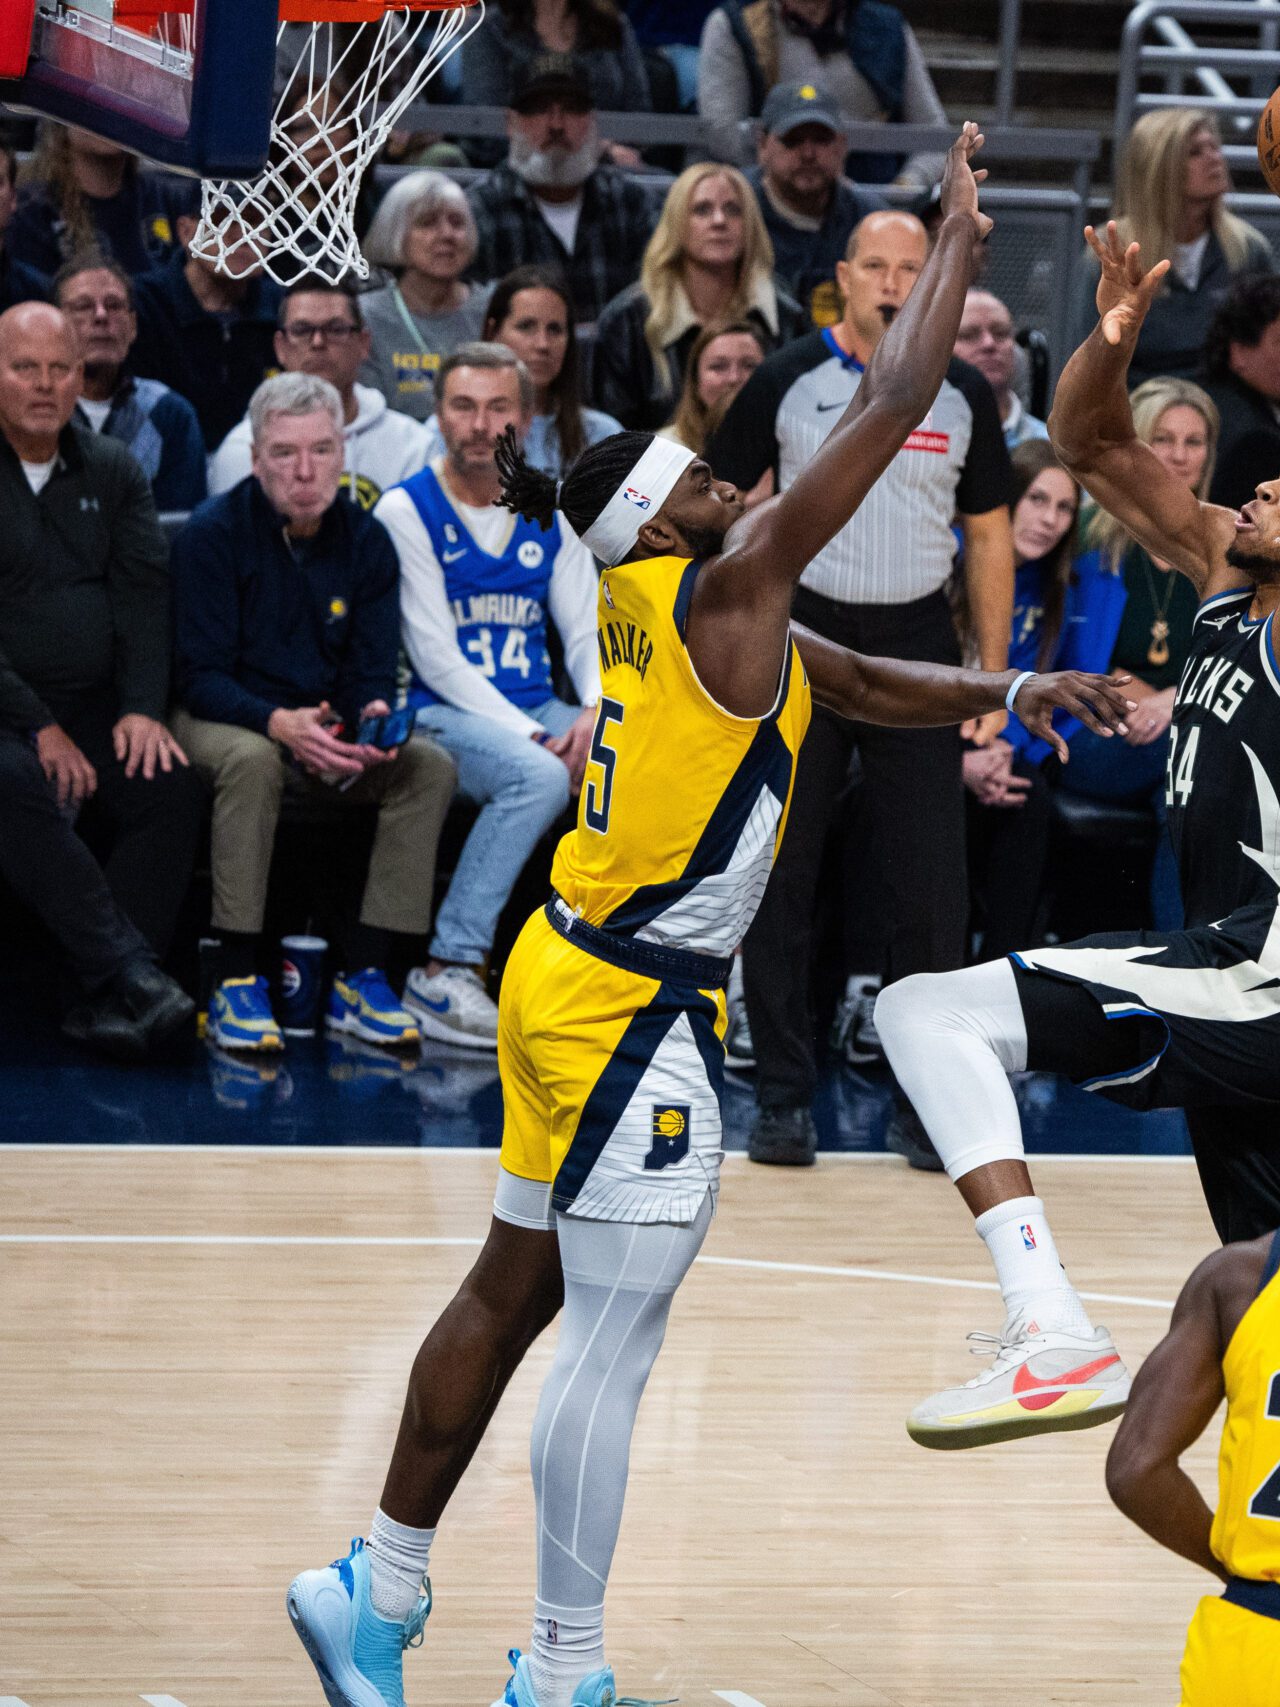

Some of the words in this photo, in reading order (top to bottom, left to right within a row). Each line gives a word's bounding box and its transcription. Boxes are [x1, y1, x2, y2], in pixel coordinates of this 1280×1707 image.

[466, 626, 531, 679] 34
[1174, 655, 1255, 725] UCKS
[585, 695, 625, 836] 5
